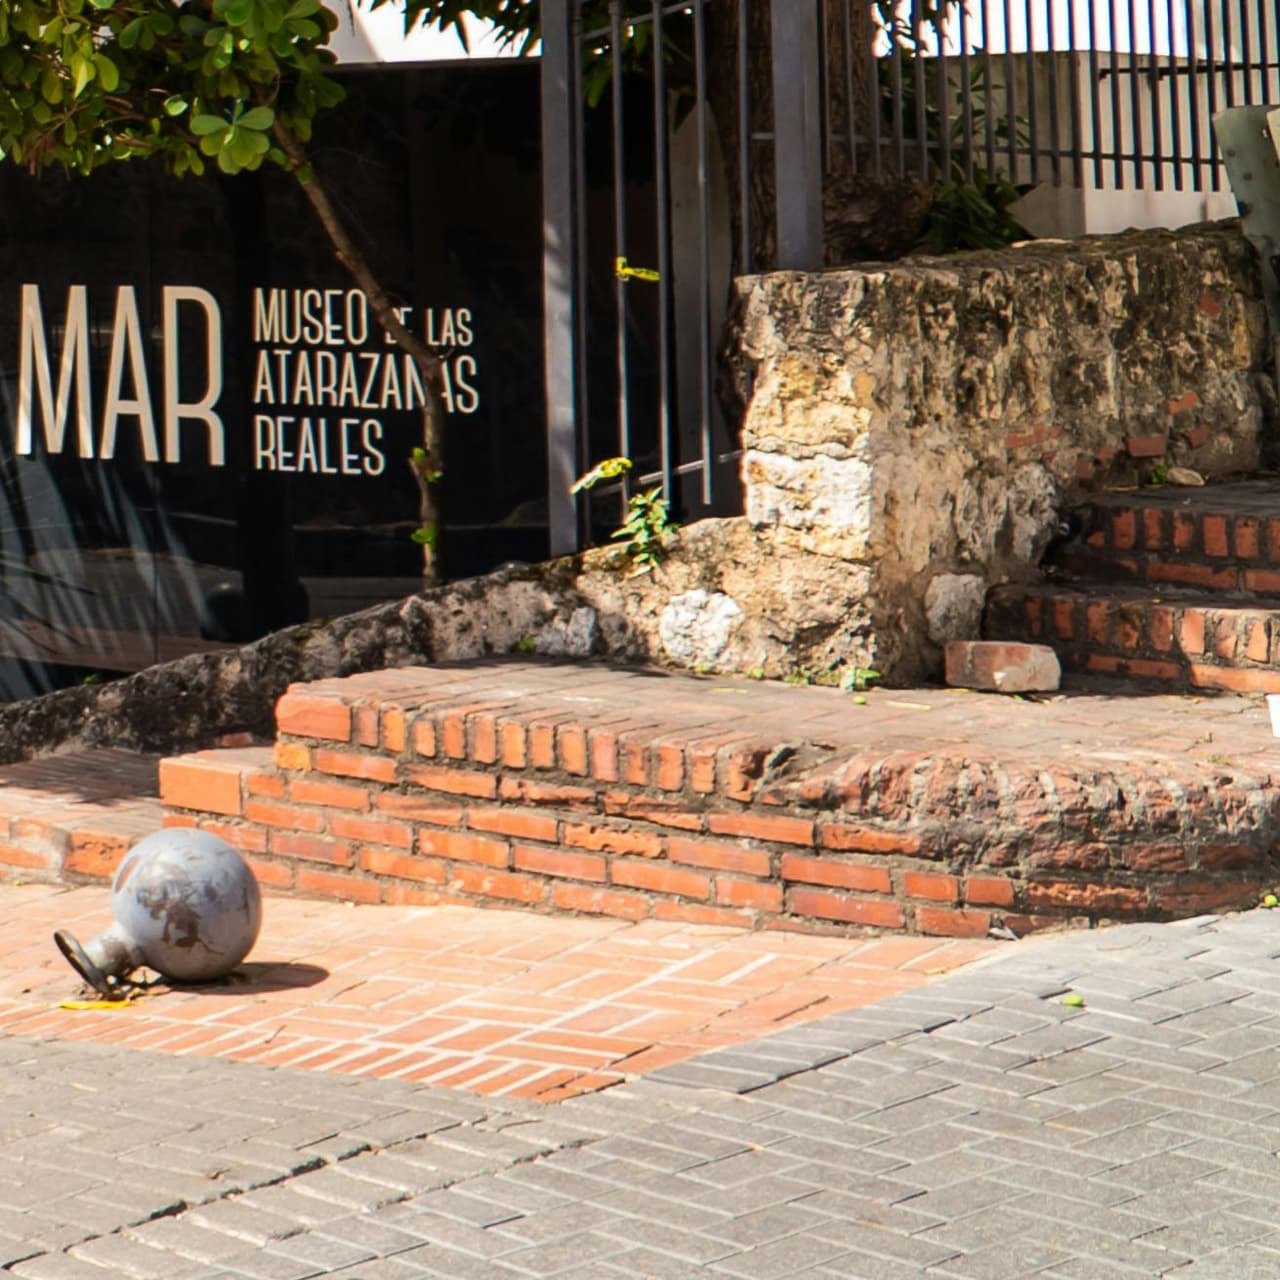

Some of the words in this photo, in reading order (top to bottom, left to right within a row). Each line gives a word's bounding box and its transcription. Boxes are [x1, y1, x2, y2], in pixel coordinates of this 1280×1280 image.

[253, 287, 369, 345] MUSEO
[426, 308, 474, 347] LAS
[16, 284, 225, 466] MAR
[254, 414, 385, 476] REALES
